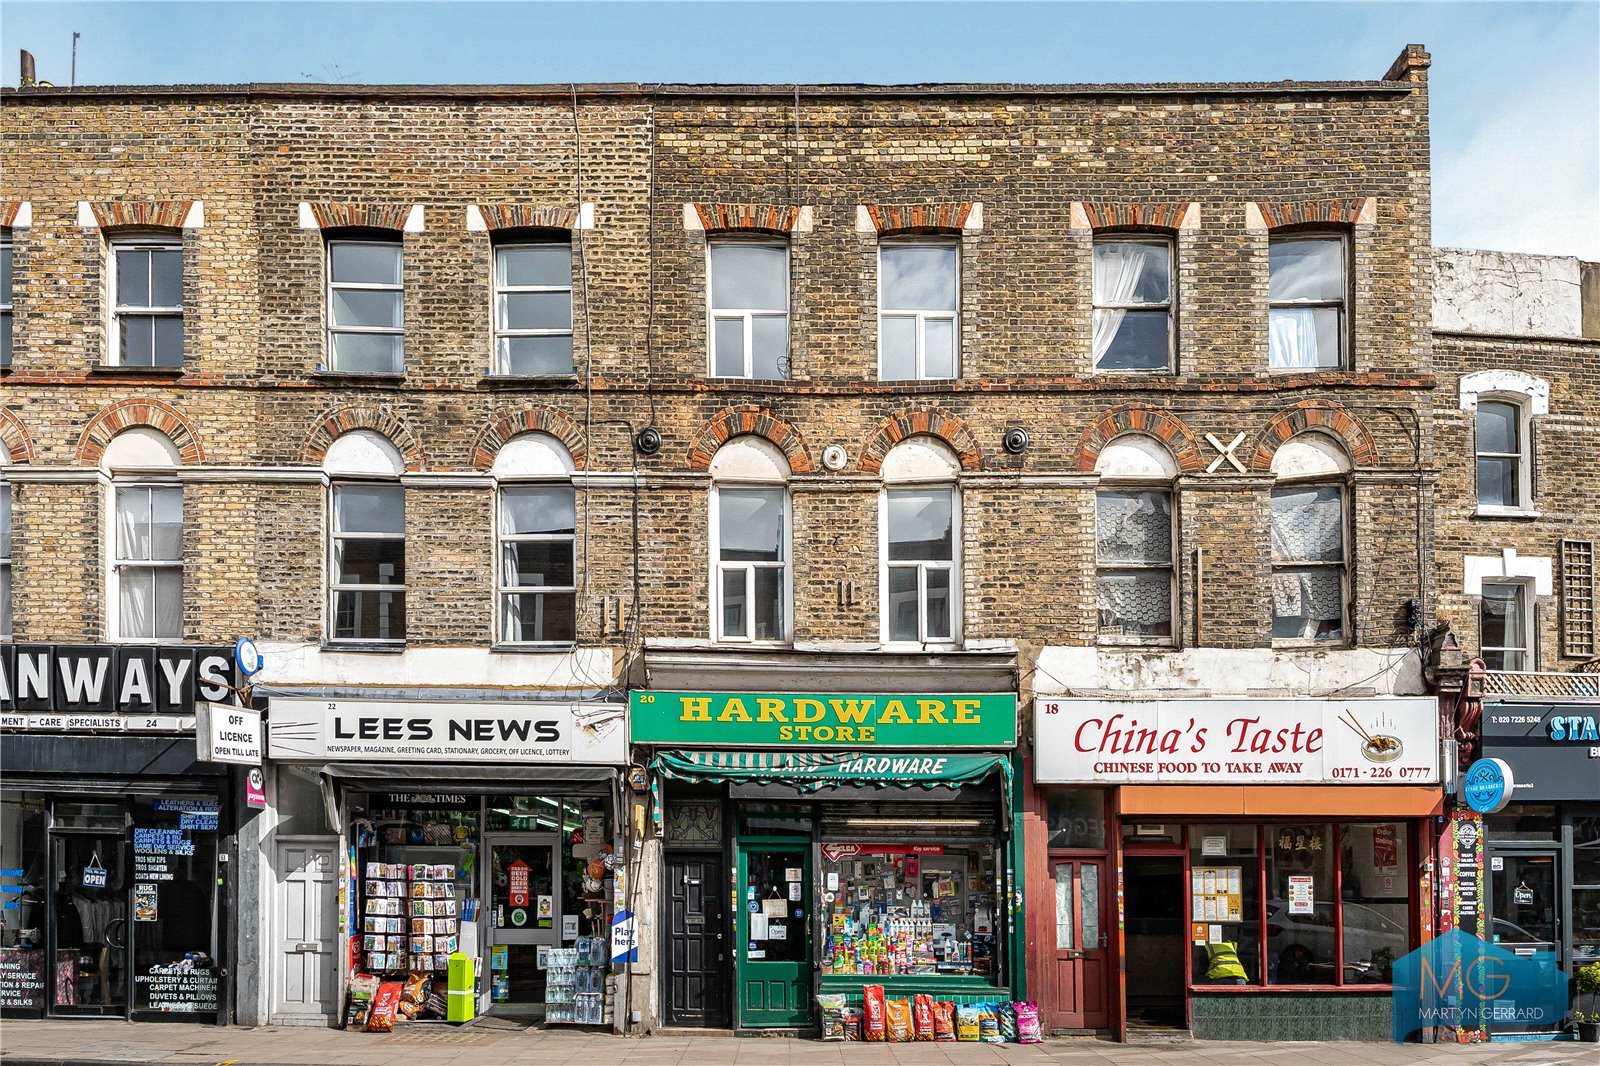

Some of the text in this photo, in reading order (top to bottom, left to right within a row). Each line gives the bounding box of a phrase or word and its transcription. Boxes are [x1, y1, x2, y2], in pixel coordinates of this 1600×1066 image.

[640, 695, 655, 703] 20
[679, 697, 981, 724] HARDWARE
[1044, 703, 1058, 714] 18
[1, 717, 24, 726] MENT
[39, 718, 61, 727] CARE
[69, 718, 121, 728] SPECIALISTS
[145, 719, 157, 728] 24
[228, 714, 244, 725] OFF
[334, 717, 561, 742] LEES NEWS
[779, 725, 875, 742] STORE
[1074, 713, 1323, 755] China's Taste
[1550, 716, 1600, 741] STA
[219, 731, 253, 743] LICENCE
[214, 746, 259, 758] OPEN TILL LATE
[327, 746, 570, 757] NEWSPAPER, MAGAZINE, GREETING CARD, STATIONARY, GROCERY, OFF LICENCE, LOTTERY
[838, 757, 948, 774] HARDWARE
[1093, 761, 1304, 774] CHINESE FOOD TO TAKE AWAY
[1332, 767, 1359, 779] 0171
[1371, 767, 1393, 779] 226
[1399, 767, 1431, 779] 0777
[389, 793, 467, 804] THE TIMES
[84, 874, 106, 885] OPEN
[1515, 890, 1532, 899] Open
[614, 927, 635, 939] Play
[770, 928, 785, 936] Open
[614, 937, 636, 946] here
[7, 972, 37, 980] SERVICE
[135, 975, 182, 984] UPHOLSTERY
[13, 998, 33, 1006] SILKS
[149, 992, 178, 1000] DUVETS
[185, 993, 217, 1001] PILLOWS
[194, 1002, 218, 1010] SUEDE
